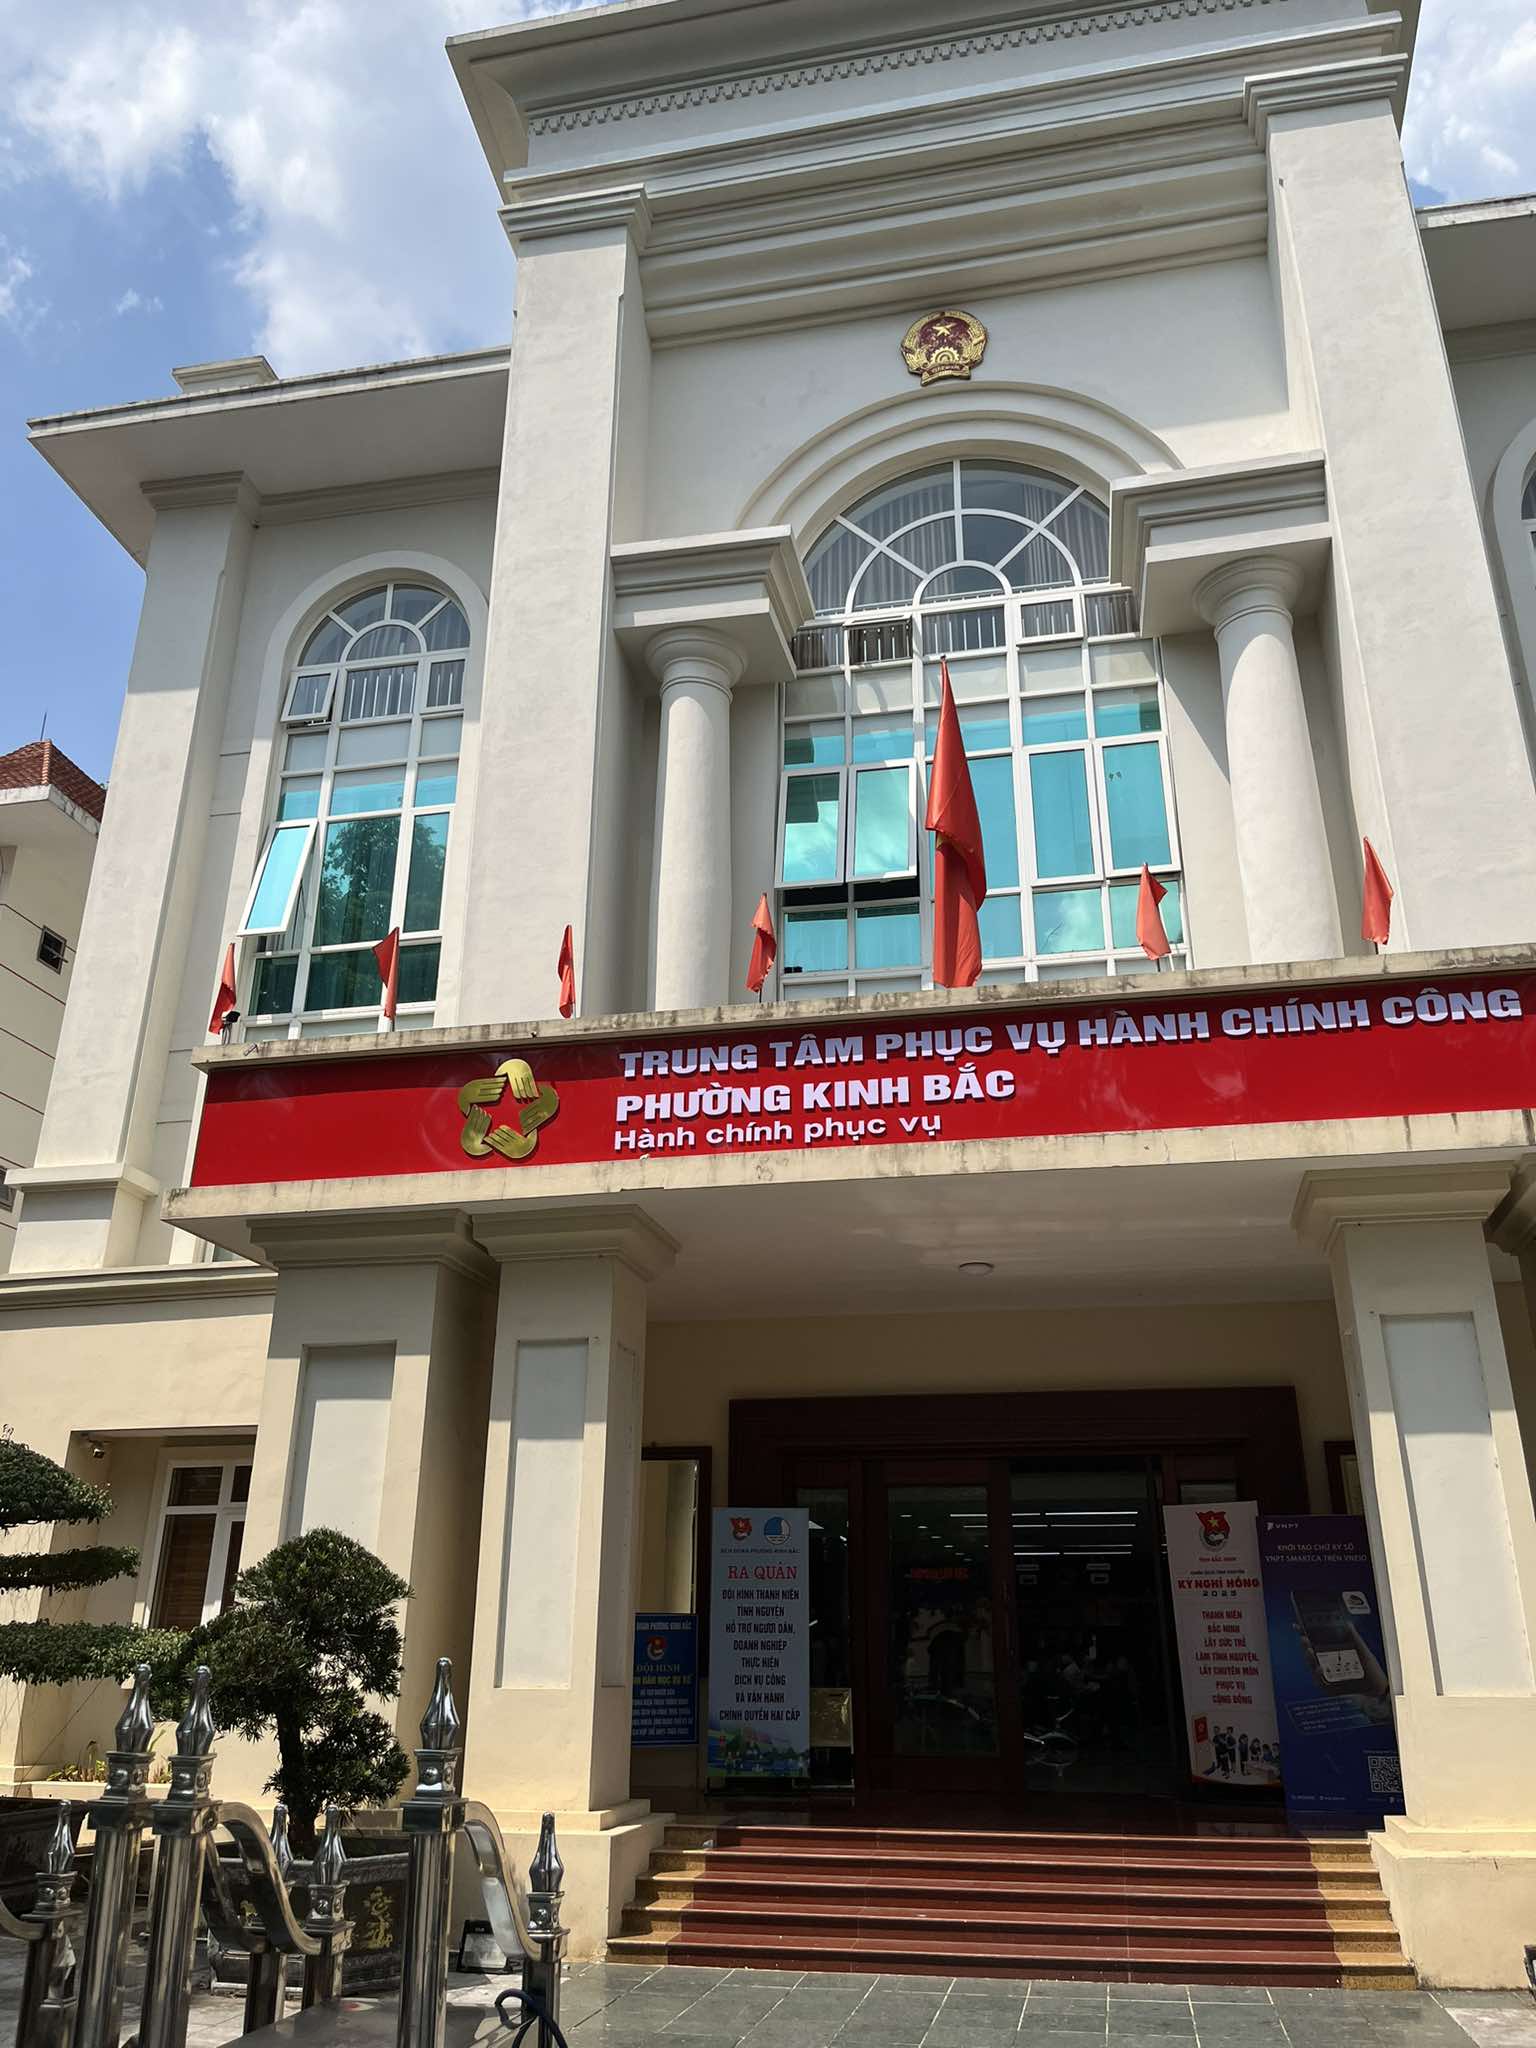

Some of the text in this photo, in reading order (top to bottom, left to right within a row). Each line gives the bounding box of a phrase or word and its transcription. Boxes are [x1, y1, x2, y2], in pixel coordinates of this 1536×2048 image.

[619, 986, 1522, 1078] TRUNG TÂM PHỤC VỤ HÀNH CHÍNH CÔNG
[615, 1062, 1015, 1122] PHƯỜNG KINH BẮC
[614, 1114, 942, 1150] Hành chính phục vụ
